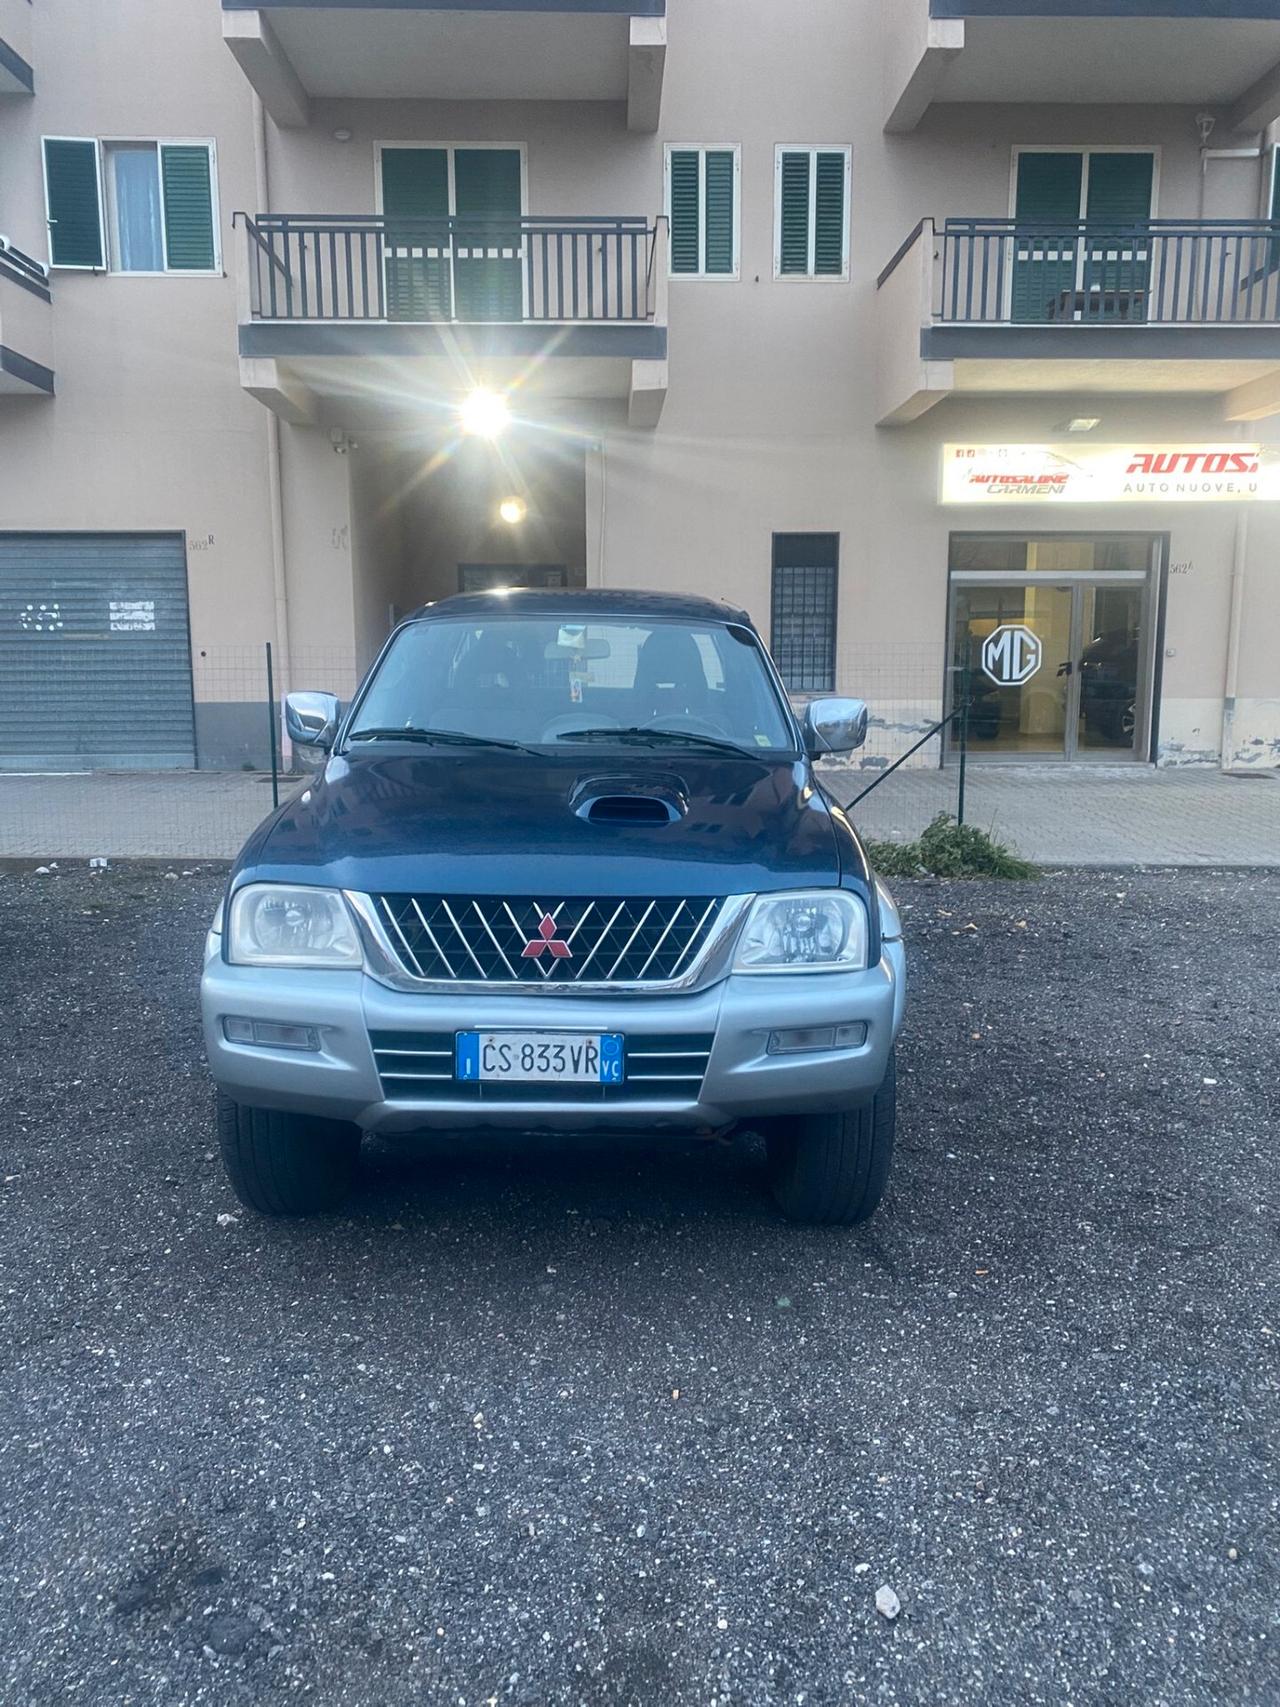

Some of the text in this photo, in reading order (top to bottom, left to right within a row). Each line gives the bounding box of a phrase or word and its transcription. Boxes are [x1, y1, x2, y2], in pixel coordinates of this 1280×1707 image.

[969, 473, 1070, 485] AUTOSALONE
[986, 484, 1066, 495] CARMENI
[1123, 482, 1170, 493] AUTO
[1175, 482, 1242, 494] NUOVE,
[987, 630, 1037, 680] MG
[601, 1060, 620, 1077] VC
